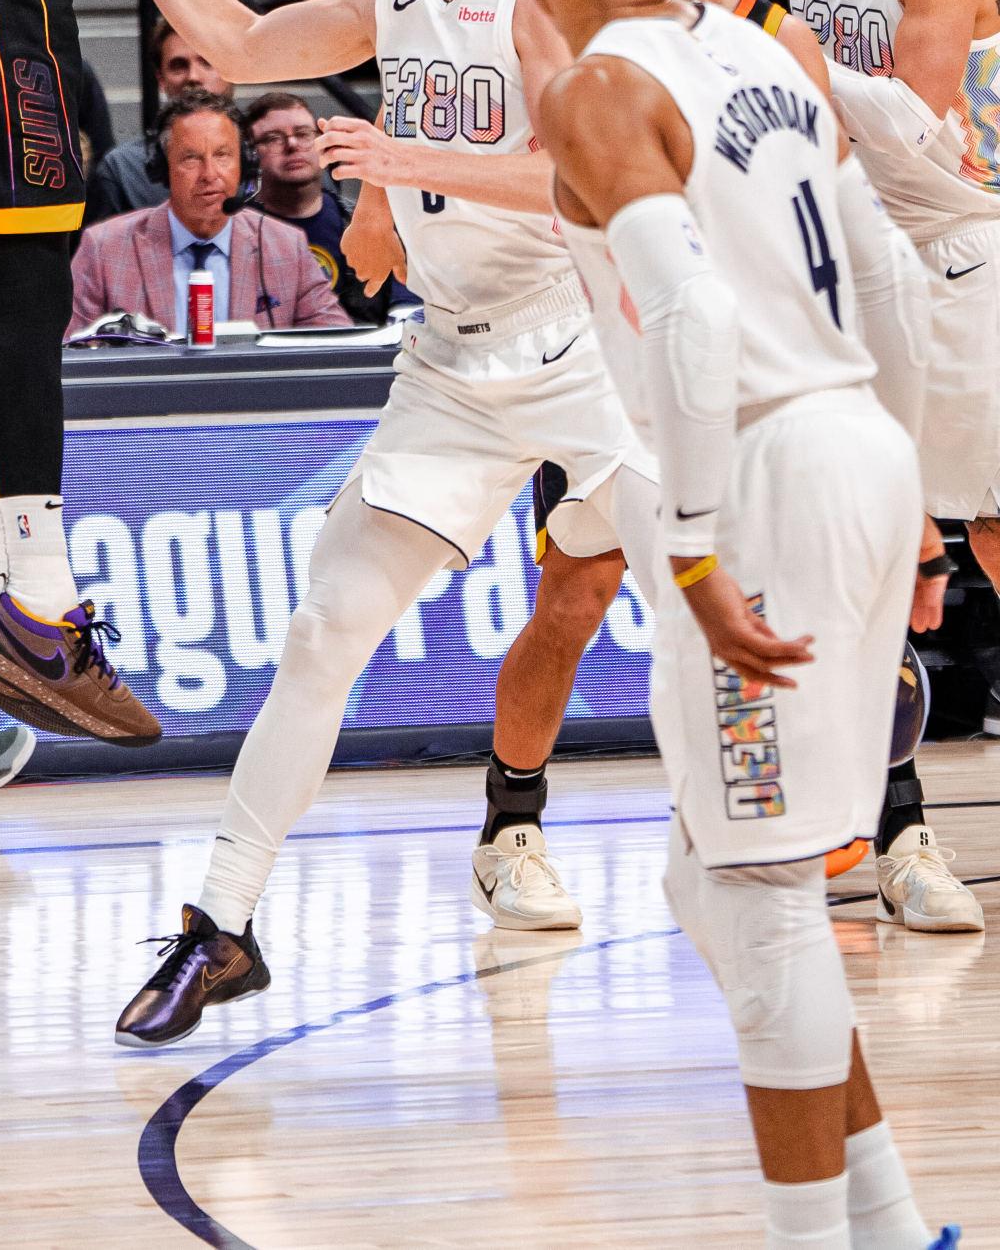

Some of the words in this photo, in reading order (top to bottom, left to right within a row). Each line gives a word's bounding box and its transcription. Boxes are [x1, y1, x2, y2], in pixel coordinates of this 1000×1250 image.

[458, 6, 495, 24] ibotta
[13, 57, 66, 189] SUNS
[791, 179, 844, 334] 4
[709, 592, 786, 821] DENV
